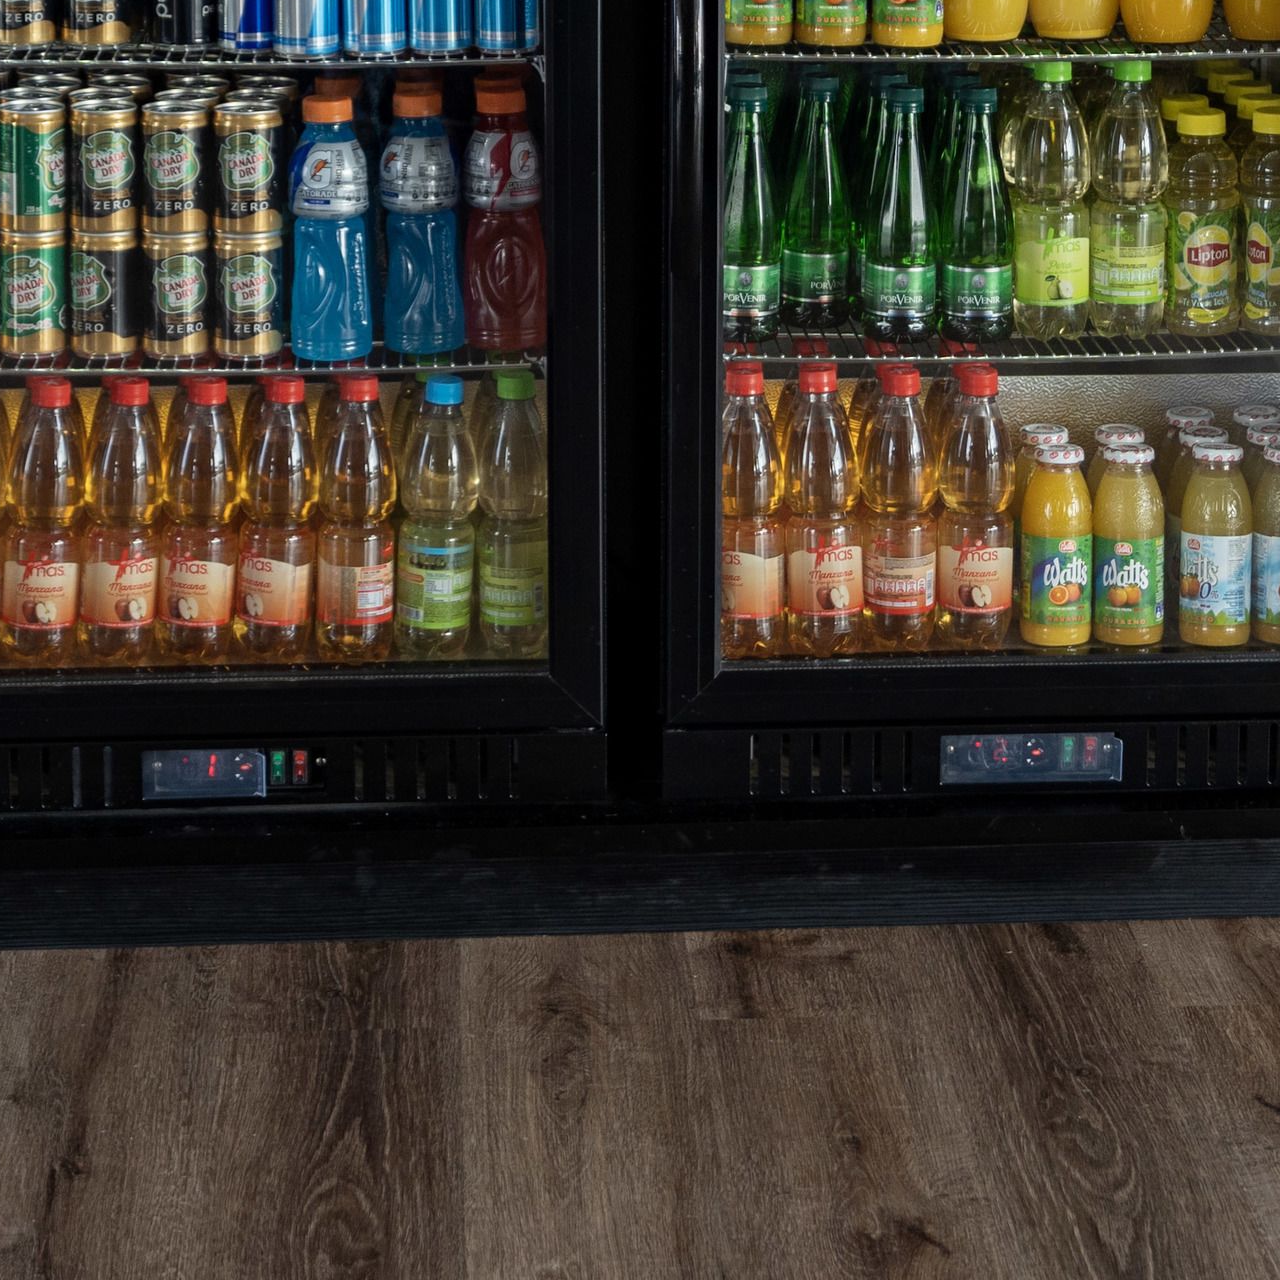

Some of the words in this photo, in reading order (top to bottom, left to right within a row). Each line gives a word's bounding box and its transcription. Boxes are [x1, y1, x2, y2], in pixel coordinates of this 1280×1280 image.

[5, 12, 44, 22] ZERO
[101, 164, 121, 177] DRY
[163, 165, 182, 177] DRY
[239, 166, 257, 178] DRY
[93, 199, 131, 210] ZERO
[155, 200, 194, 210] ZERO
[231, 201, 269, 211] ZERO
[1191, 248, 1229, 262] Lipton
[7, 277, 45, 294] CANADA
[162, 275, 200, 292] CANADA
[231, 275, 268, 292] CANADA
[17, 291, 38, 304] DRY
[175, 288, 194, 301] DRY
[242, 288, 261, 301] DRY
[167, 322, 204, 333] ZERO
[234, 322, 271, 333] ZERO
[953, 568, 998, 578] Manzana
[17, 582, 64, 594] Manzana
[109, 581, 153, 593] Manzana
